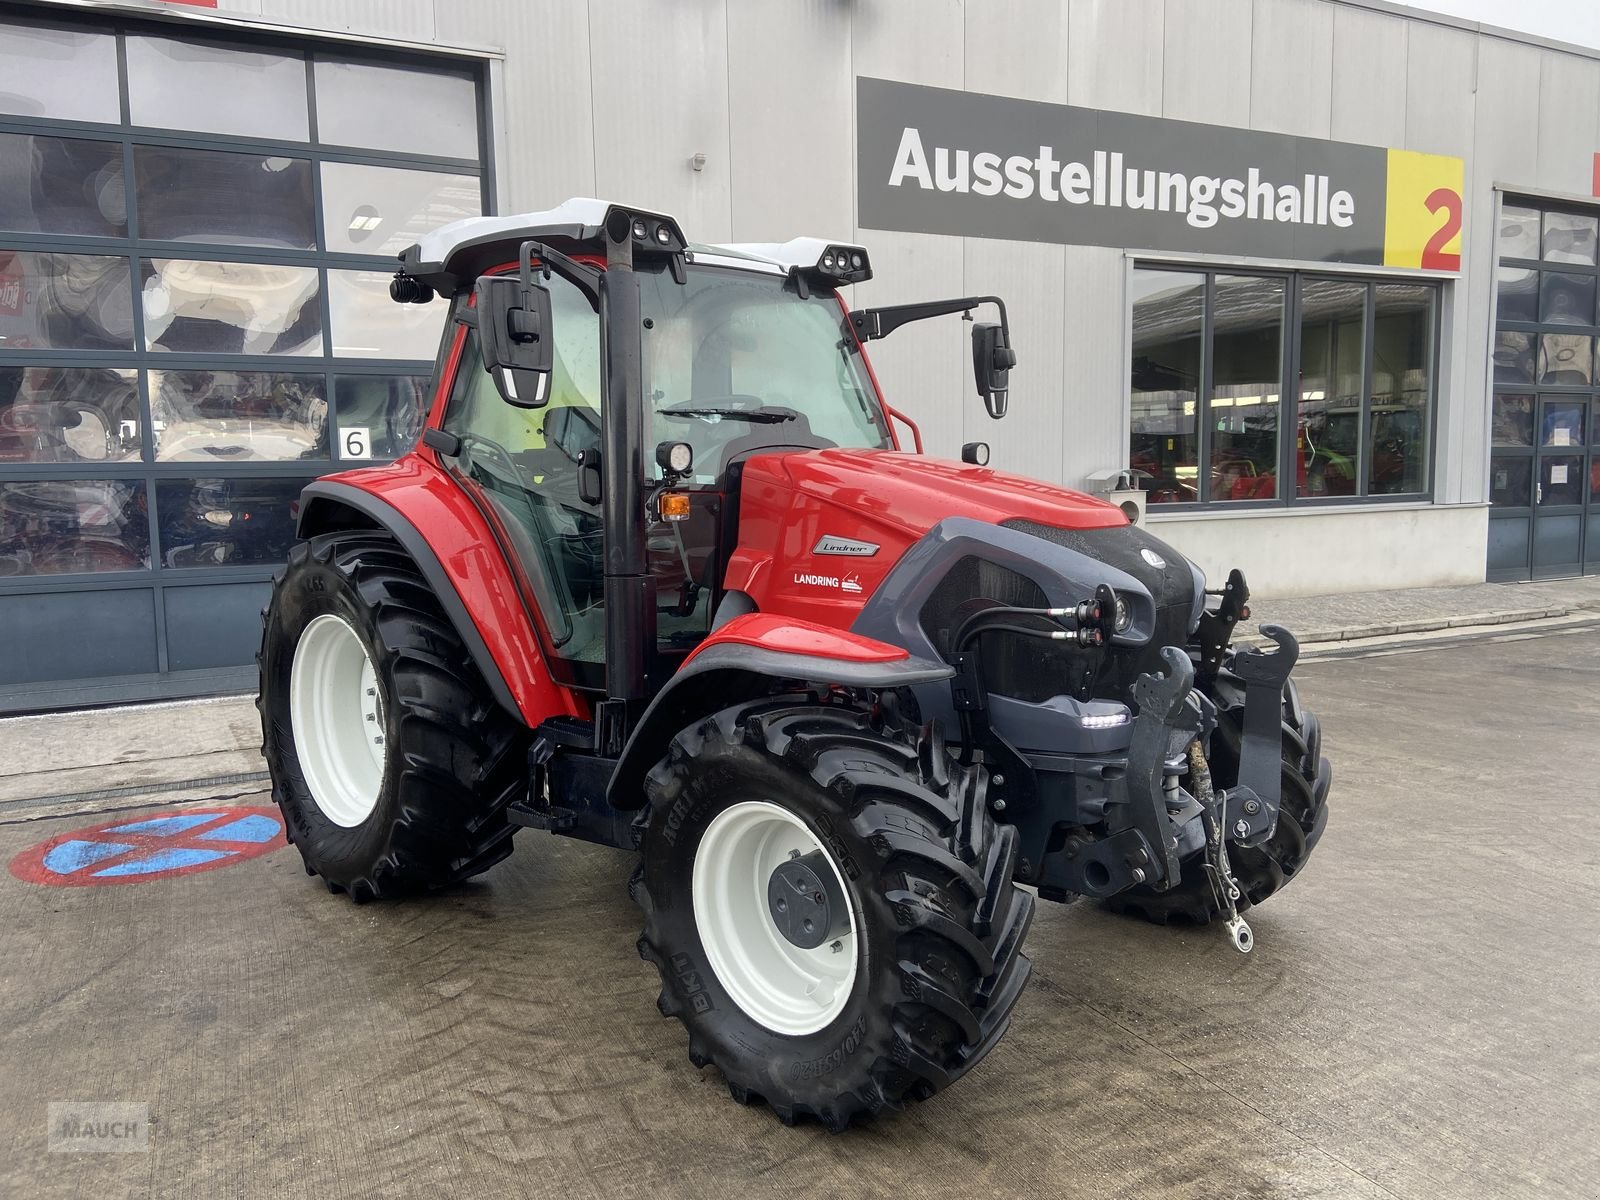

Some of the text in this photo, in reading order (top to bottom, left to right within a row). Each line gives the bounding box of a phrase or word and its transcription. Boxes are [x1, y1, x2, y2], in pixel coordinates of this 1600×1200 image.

[888, 127, 1463, 271] Ausstellungshalle 2
[346, 431, 363, 456] 6
[823, 543, 867, 552] Lindner
[794, 573, 839, 588] LANDRING
[671, 955, 712, 1014] BKT
